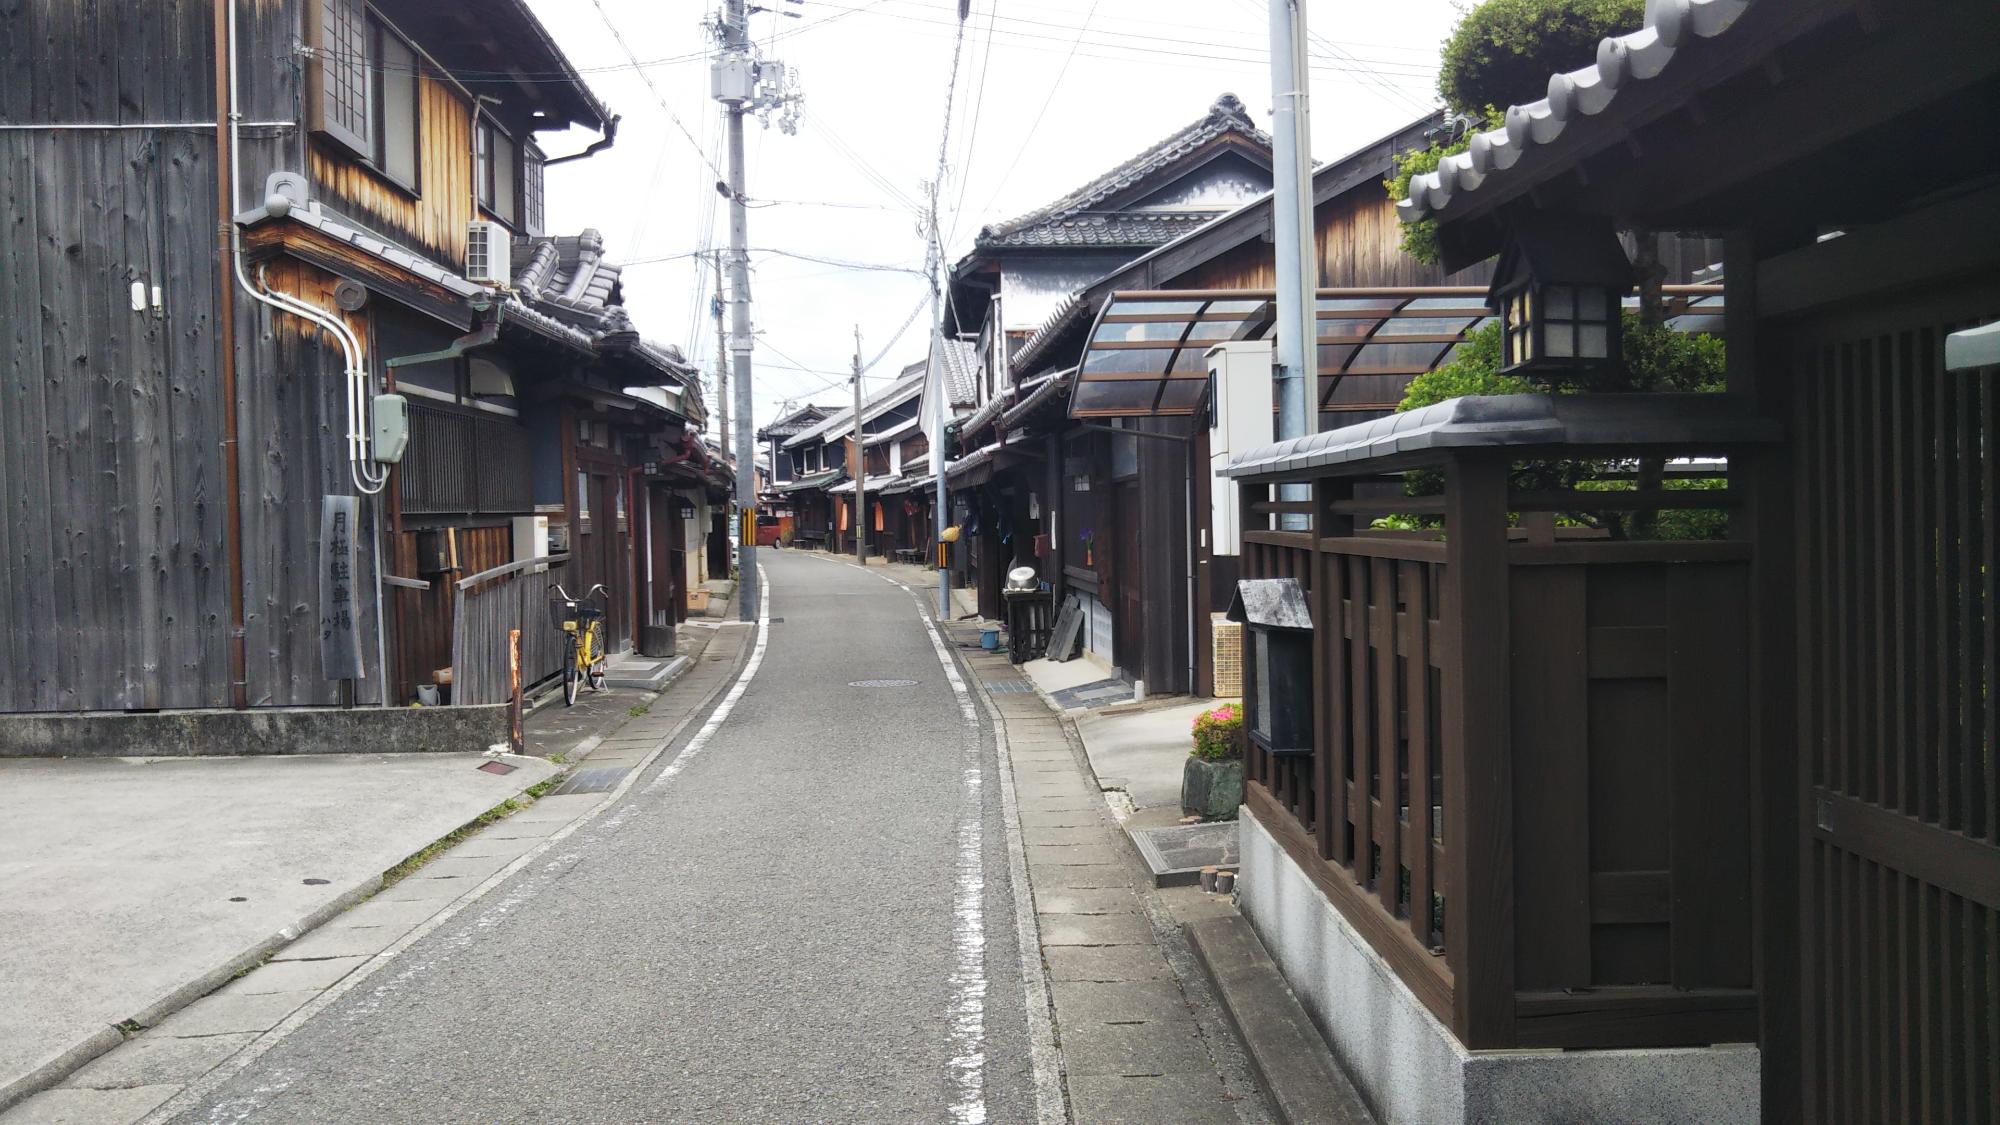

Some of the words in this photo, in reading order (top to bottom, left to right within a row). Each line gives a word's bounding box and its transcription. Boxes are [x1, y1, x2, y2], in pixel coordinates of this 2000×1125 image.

[330, 511, 351, 631] 月極駐車場
